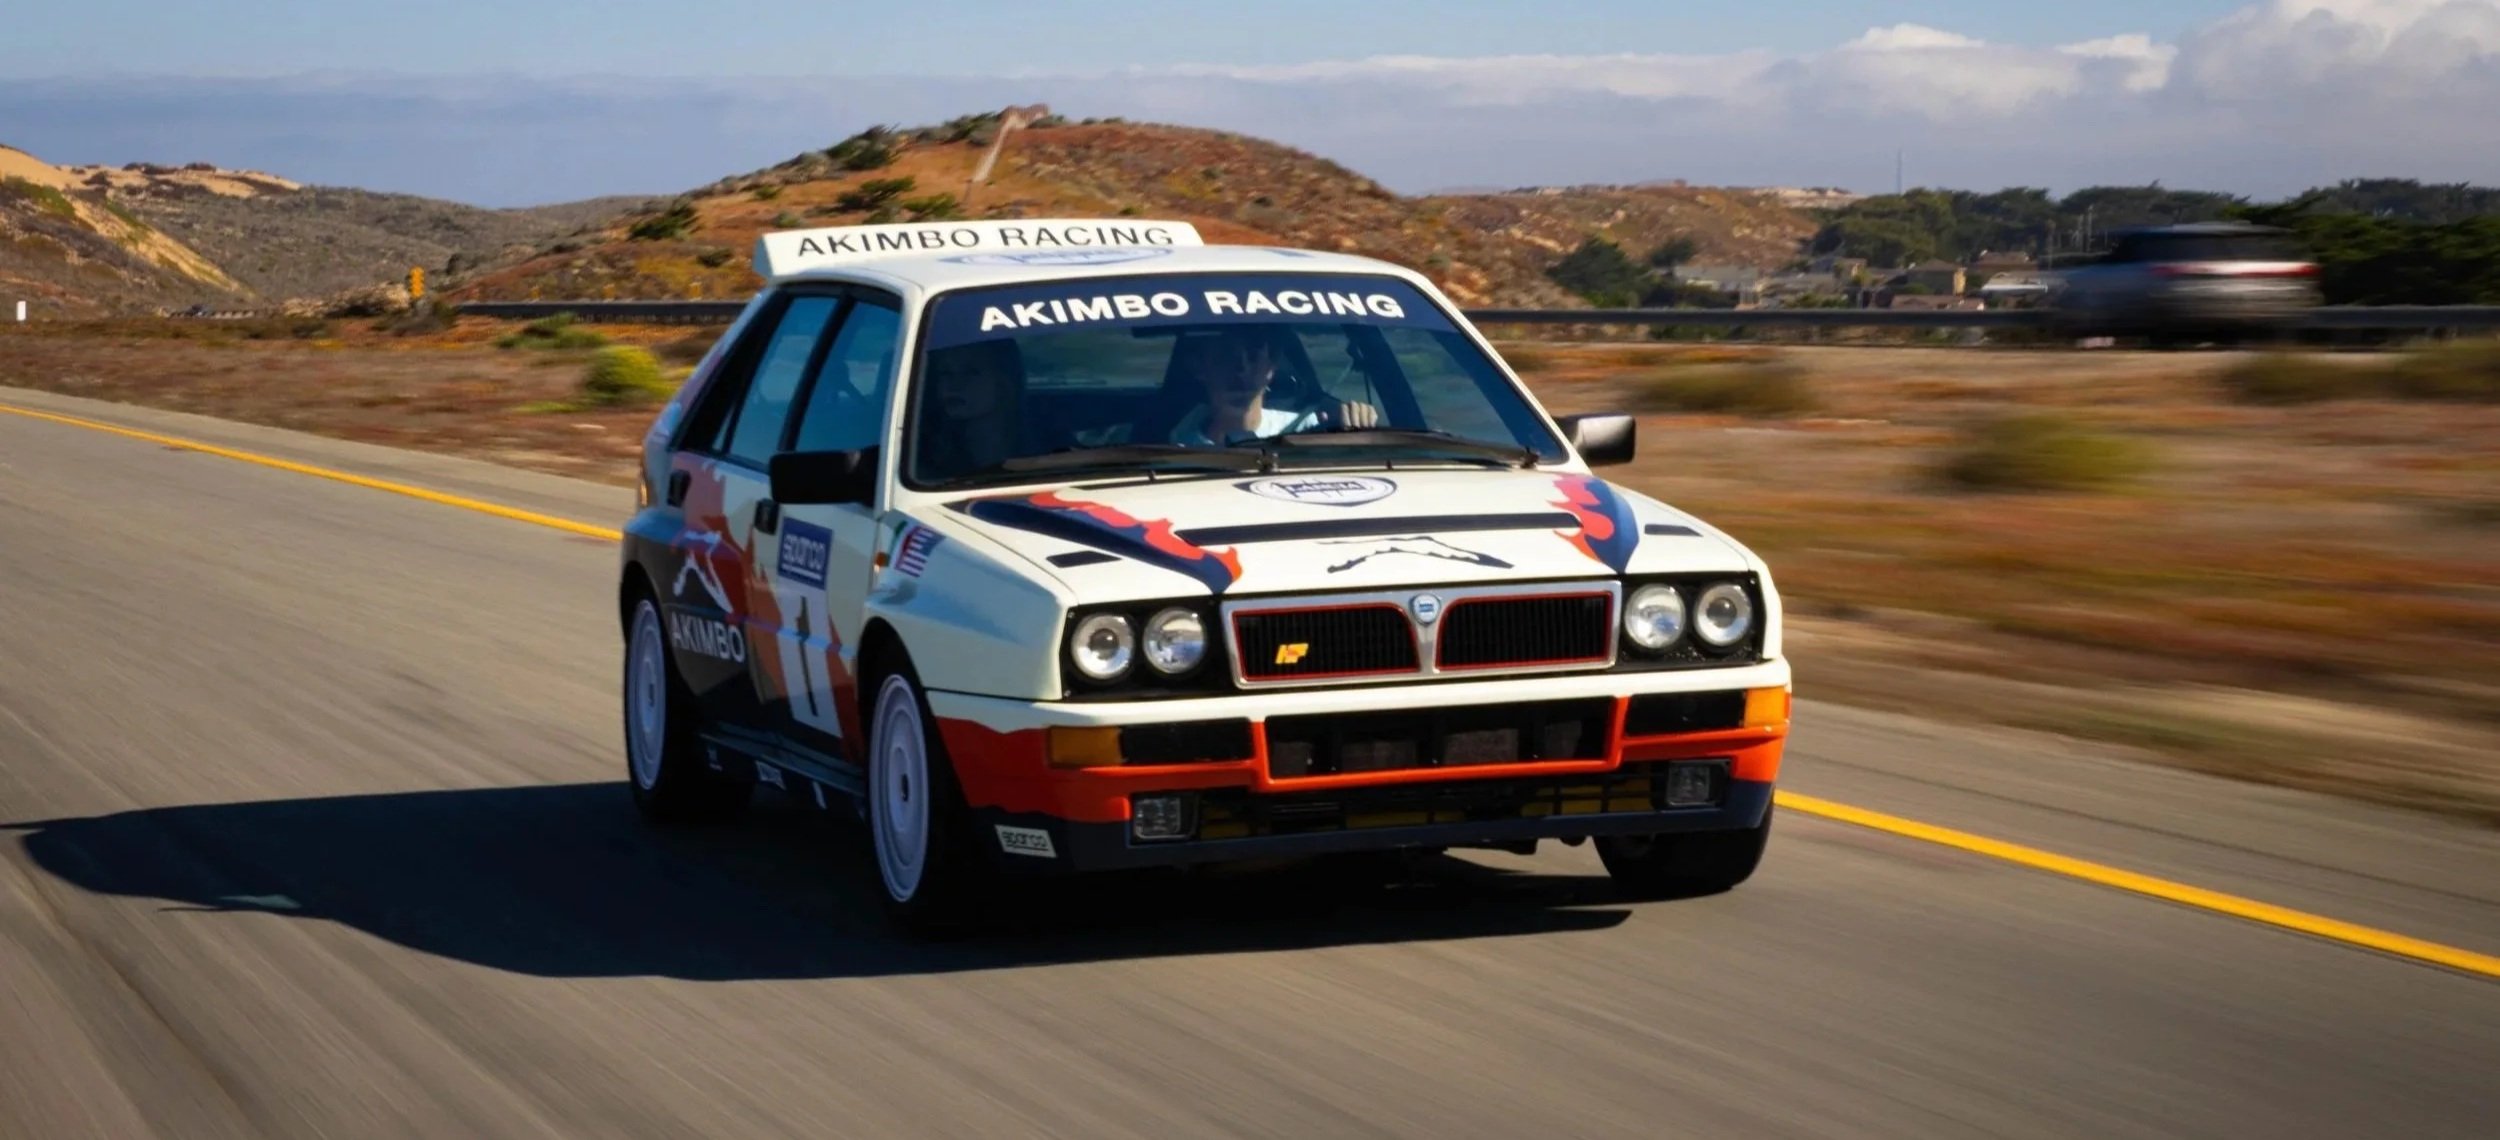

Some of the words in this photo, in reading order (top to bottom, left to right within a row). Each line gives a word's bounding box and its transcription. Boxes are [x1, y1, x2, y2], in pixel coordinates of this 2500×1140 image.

[798, 227, 980, 257] AKIMBO
[998, 226, 1174, 247] RACING
[980, 292, 1190, 331] AKIMBO
[1204, 290, 1405, 318] RACING
[672, 611, 745, 662] AKIMBO
